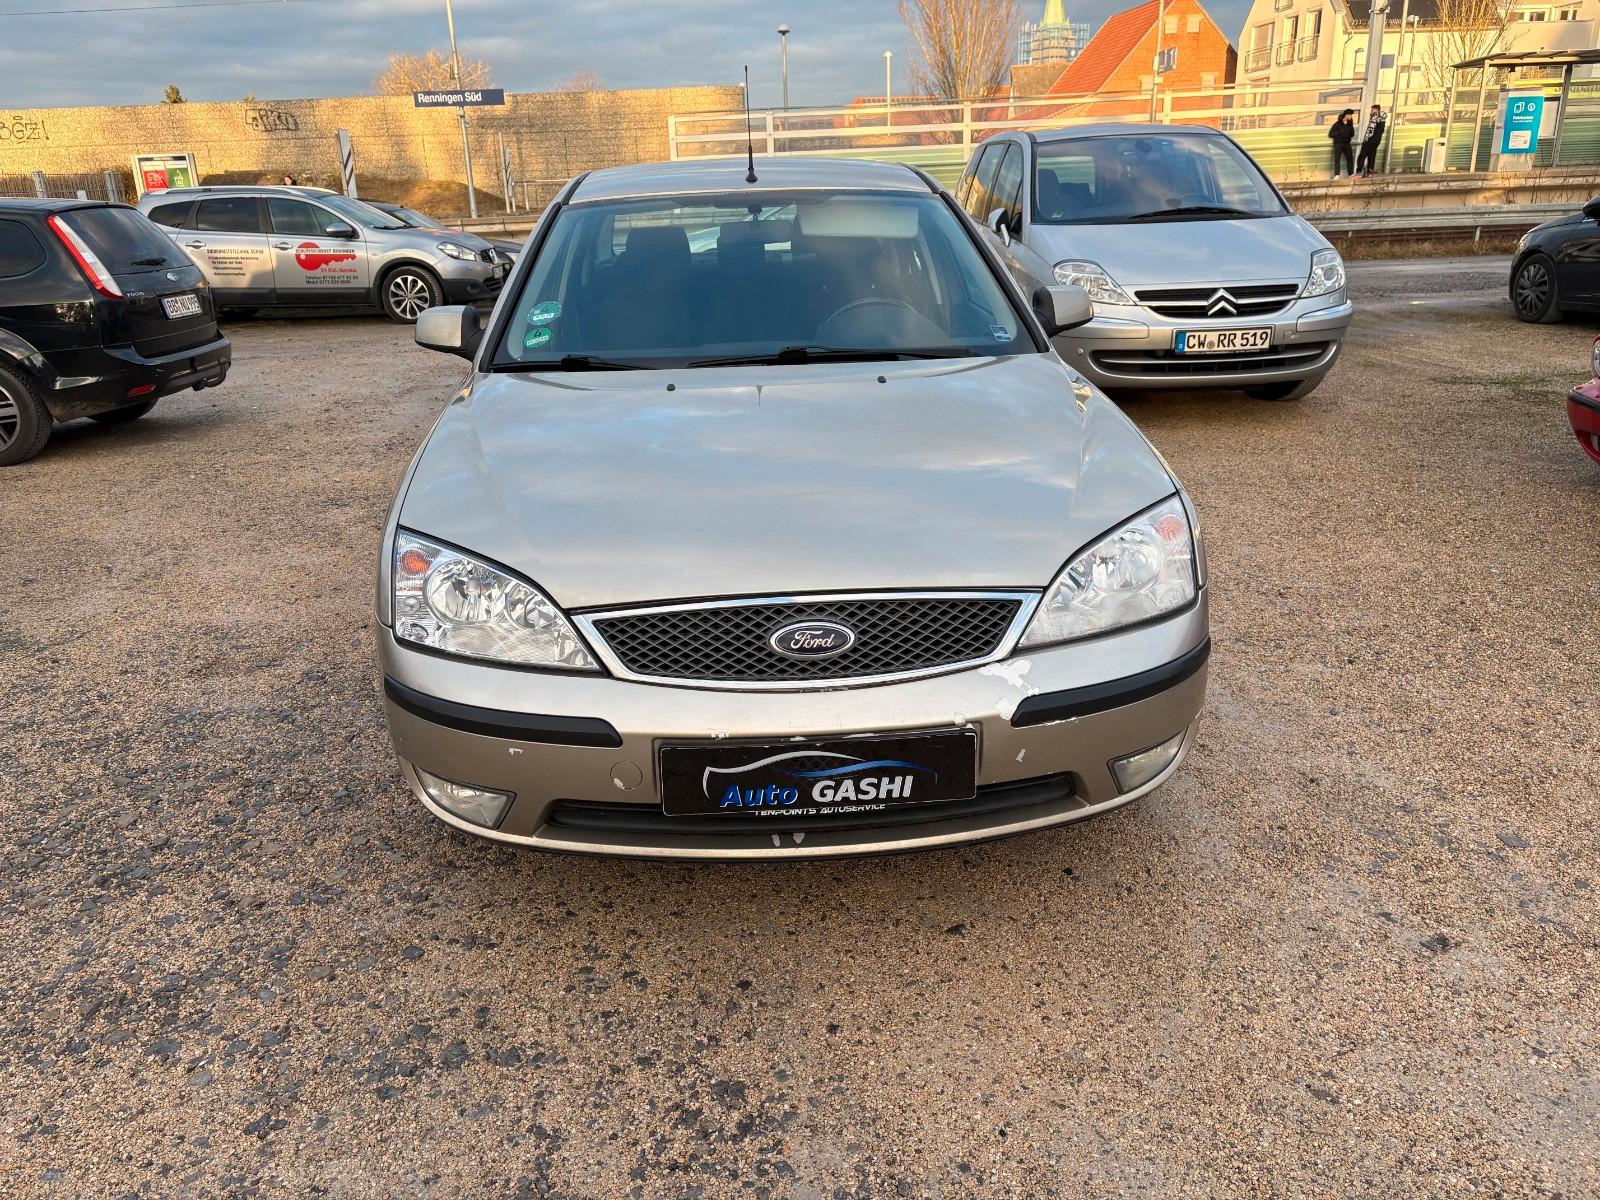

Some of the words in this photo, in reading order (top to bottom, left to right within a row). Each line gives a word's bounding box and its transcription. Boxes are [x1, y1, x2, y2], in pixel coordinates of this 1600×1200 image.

[418, 93, 463, 103] Renningen
[465, 92, 482, 101] Süd
[1186, 334, 1207, 349] CW
[1217, 333, 1237, 348] RR
[1240, 331, 1269, 347] 519
[790, 630, 835, 649] Ford
[720, 785, 799, 808] Auto
[811, 775, 914, 803] GASHI
